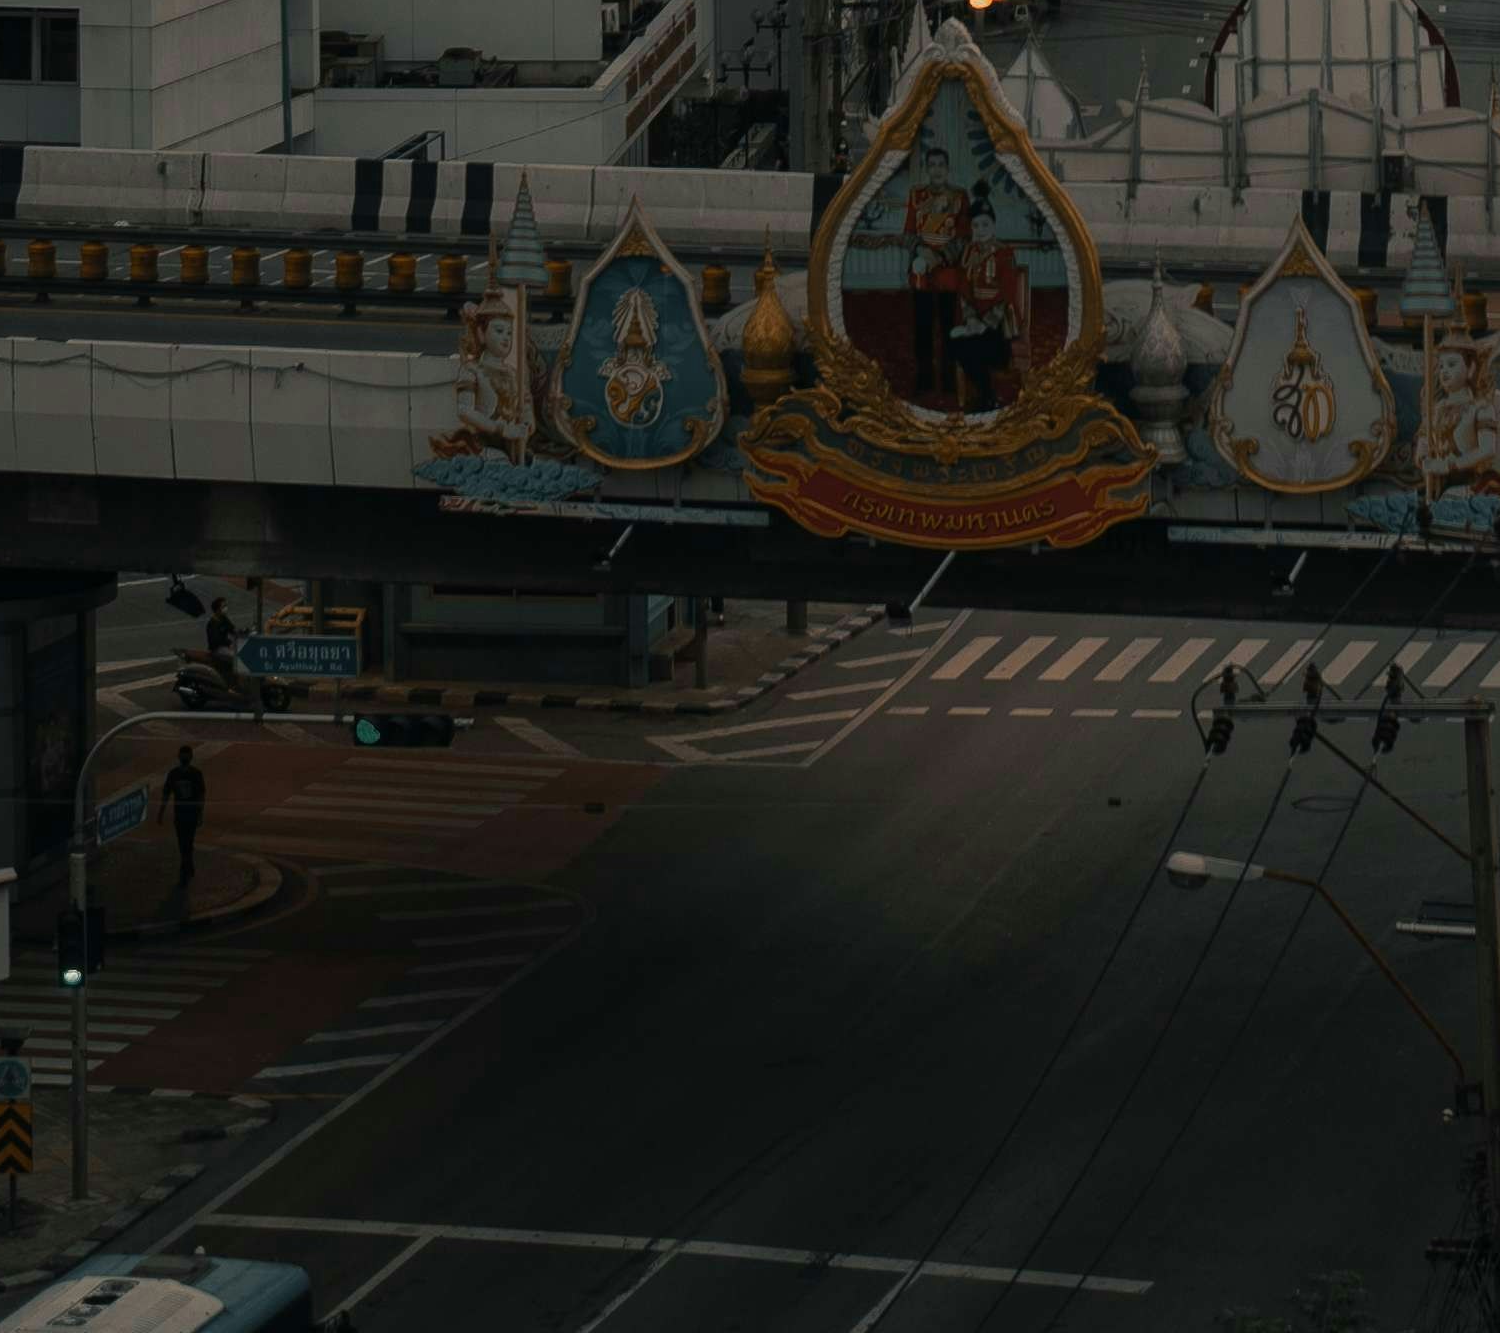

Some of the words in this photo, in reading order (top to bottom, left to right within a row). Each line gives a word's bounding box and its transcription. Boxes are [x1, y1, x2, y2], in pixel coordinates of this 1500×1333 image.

[842, 491, 1056, 531] กรุงเทพมหานคร
[276, 641, 351, 662] ศรีอยุธยา
